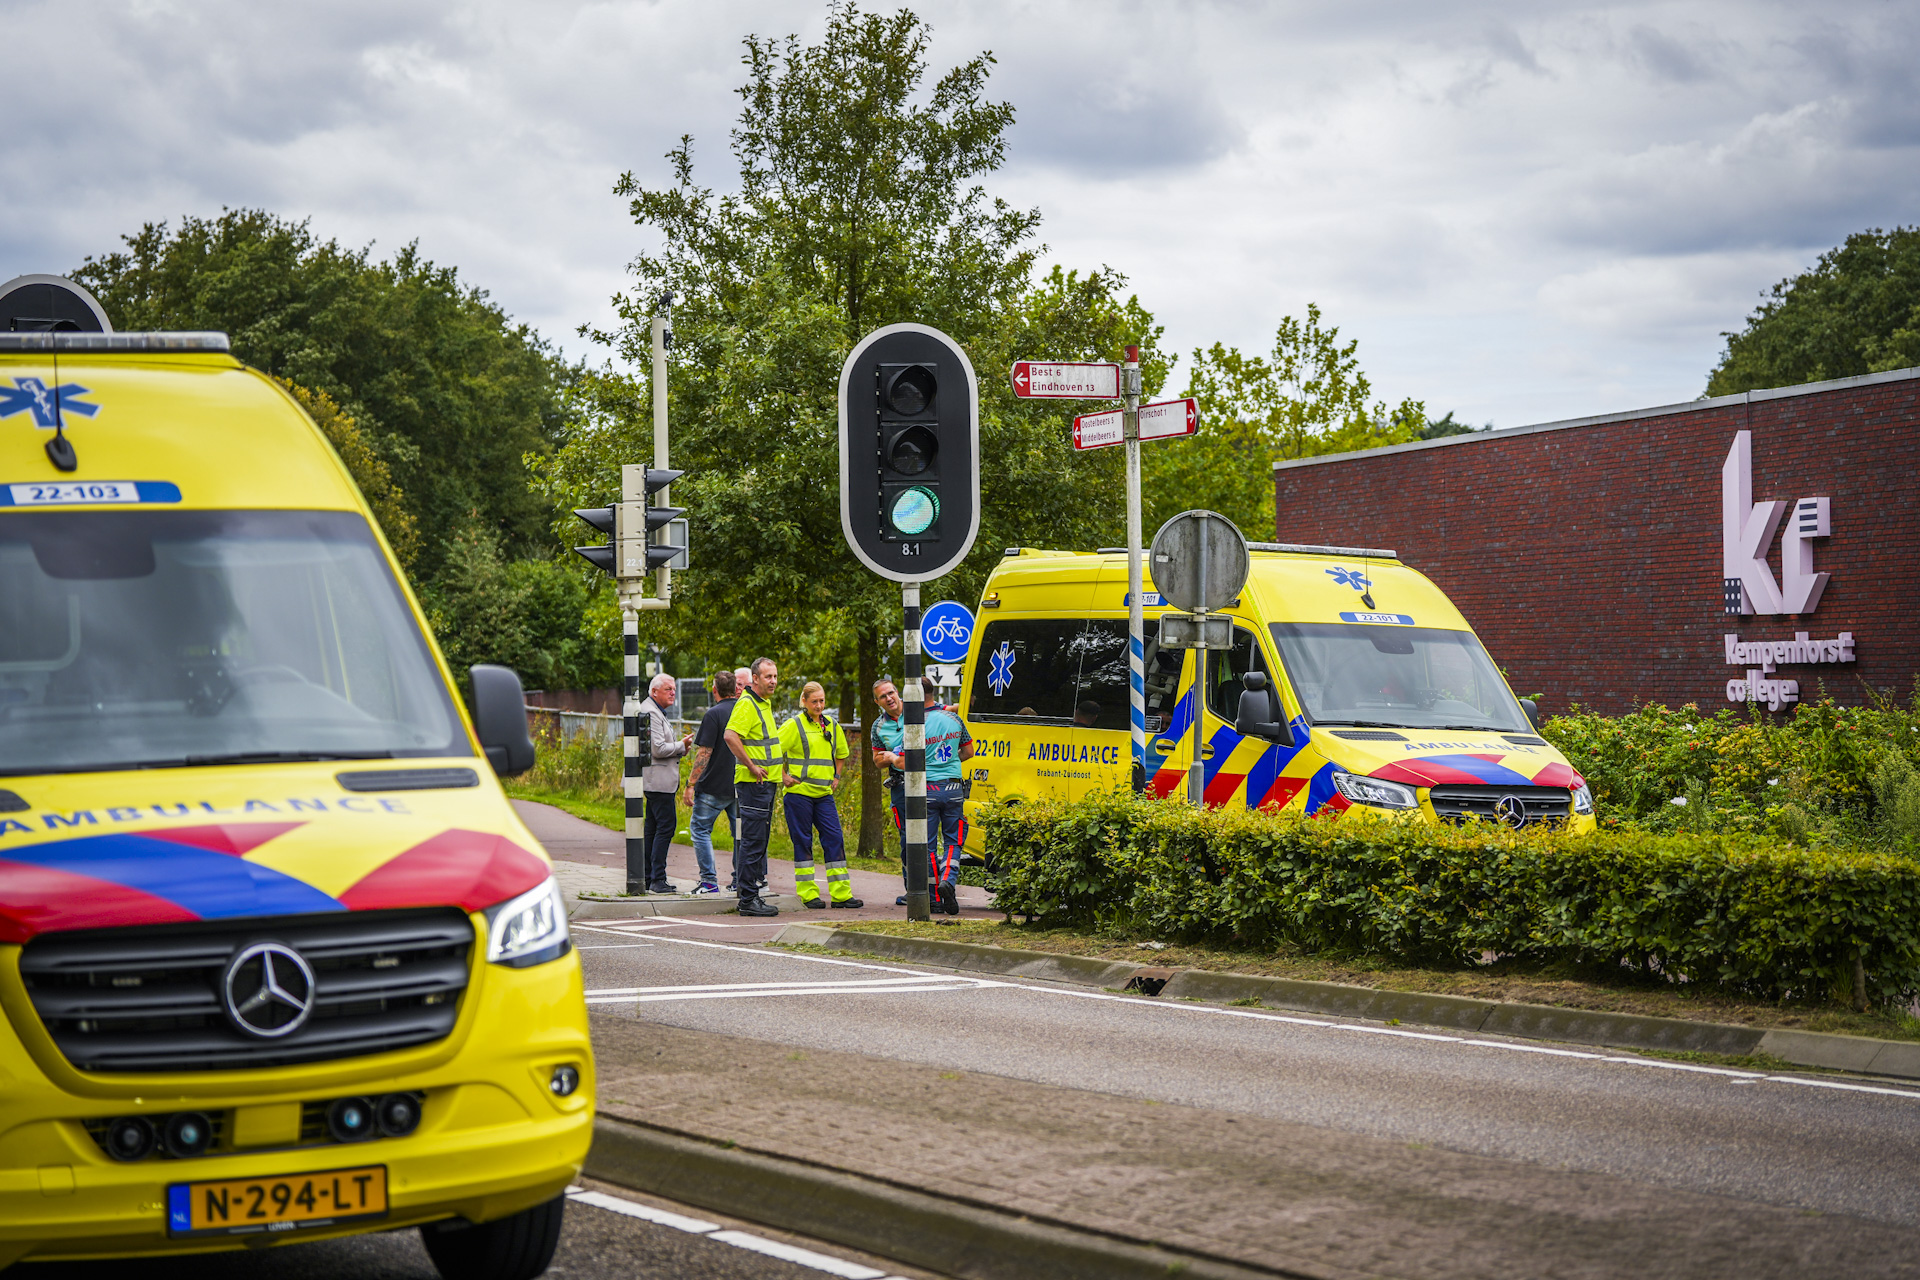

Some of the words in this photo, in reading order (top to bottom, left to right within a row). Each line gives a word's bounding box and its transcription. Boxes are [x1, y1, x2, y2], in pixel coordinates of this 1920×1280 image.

[1031, 367, 1053, 377] Best
[1056, 369, 1062, 377] 6
[1032, 381, 1083, 392] Eindhoven
[1085, 384, 1095, 392] 13
[1139, 409, 1163, 419] Oirschot
[1081, 416, 1110, 428] Oostelbeers
[1081, 433, 1111, 443] Middelbeers
[30, 485, 121, 500] 22-103
[902, 543, 920, 556] 8.1
[626, 558, 642, 567] 22.1
[1361, 614, 1394, 622] 22-101
[1724, 631, 1855, 673] kempenhorst
[1726, 669, 1799, 712] college
[925, 731, 962, 745] MBULANCE
[975, 739, 1012, 758] 22-101
[1028, 743, 1119, 765] AMBULANCE
[1404, 742, 1541, 755] AMBULANCE
[1037, 768, 1091, 779] Brabant-Zuidoost
[0, 797, 412, 837] AMBULANCE
[206, 1174, 372, 1222] N-294-LT
